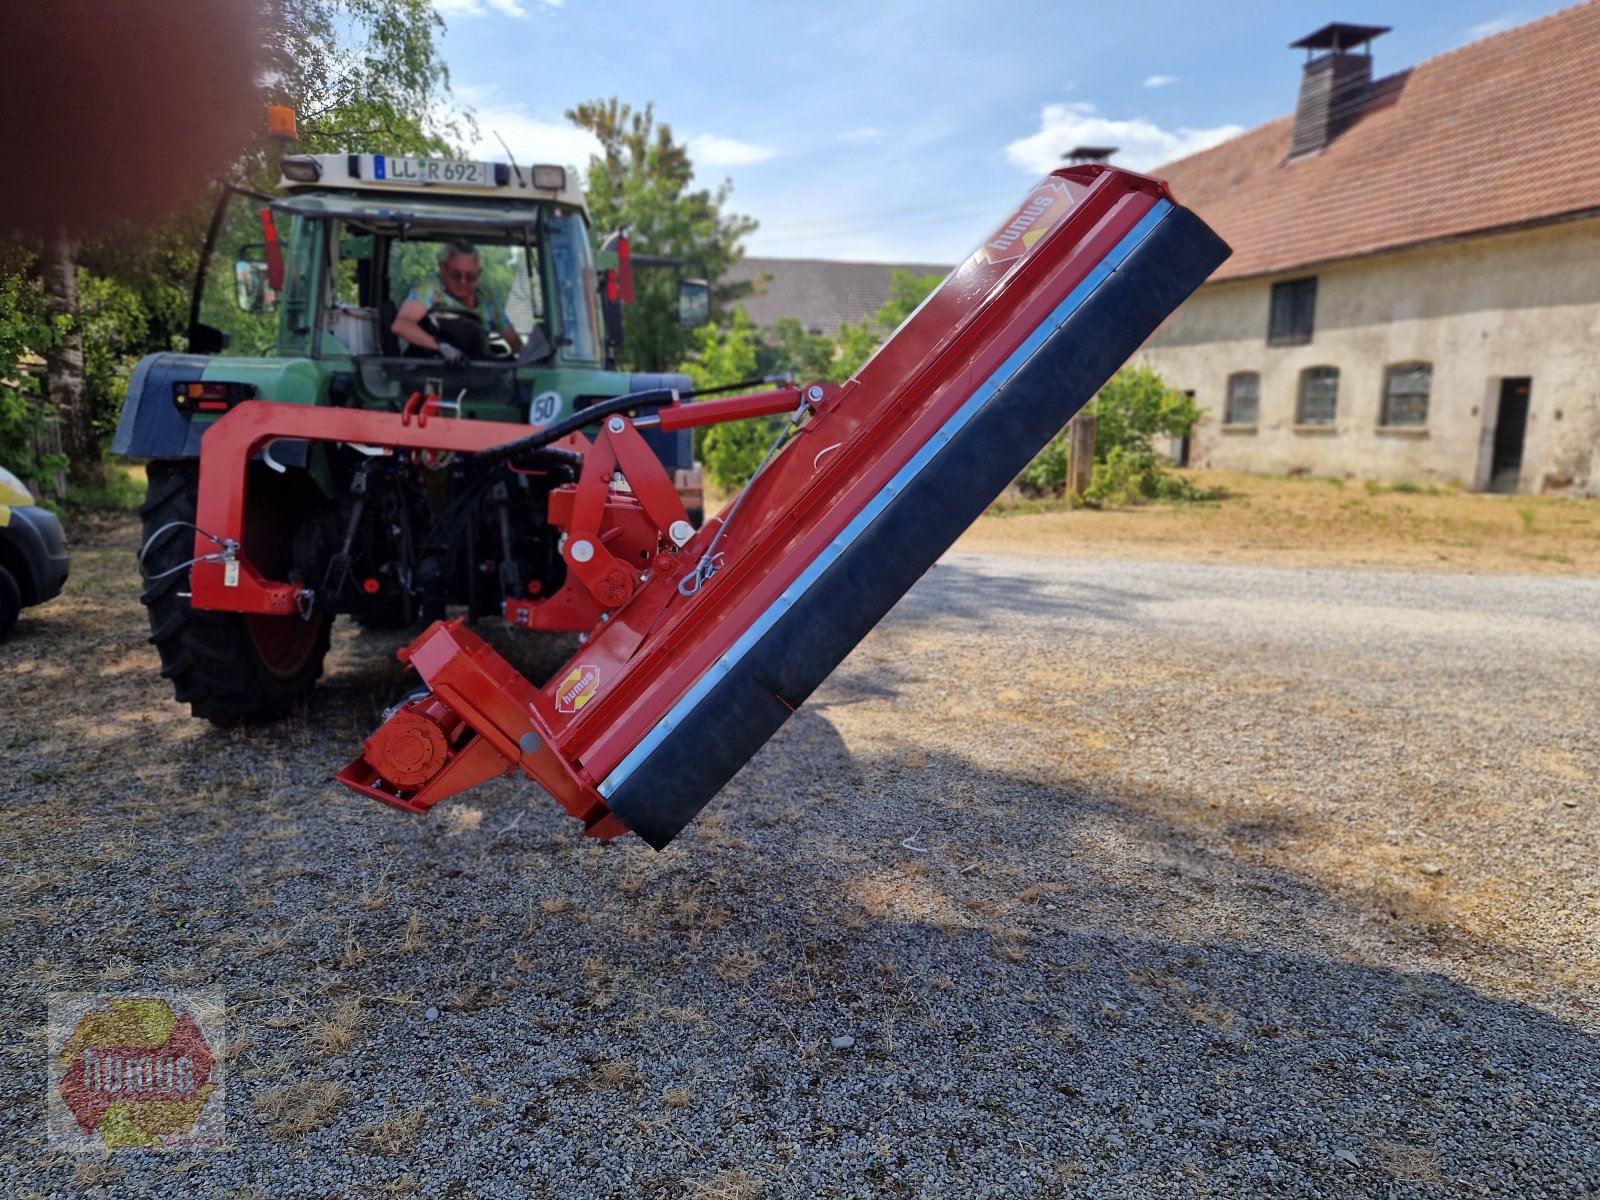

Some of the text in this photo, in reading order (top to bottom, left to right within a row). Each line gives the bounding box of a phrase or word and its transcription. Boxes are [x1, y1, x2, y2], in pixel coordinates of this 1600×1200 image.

[391, 159, 477, 182] LL R 692
[989, 195, 1055, 252] humus
[535, 395, 555, 422] 50
[562, 671, 594, 705] humus
